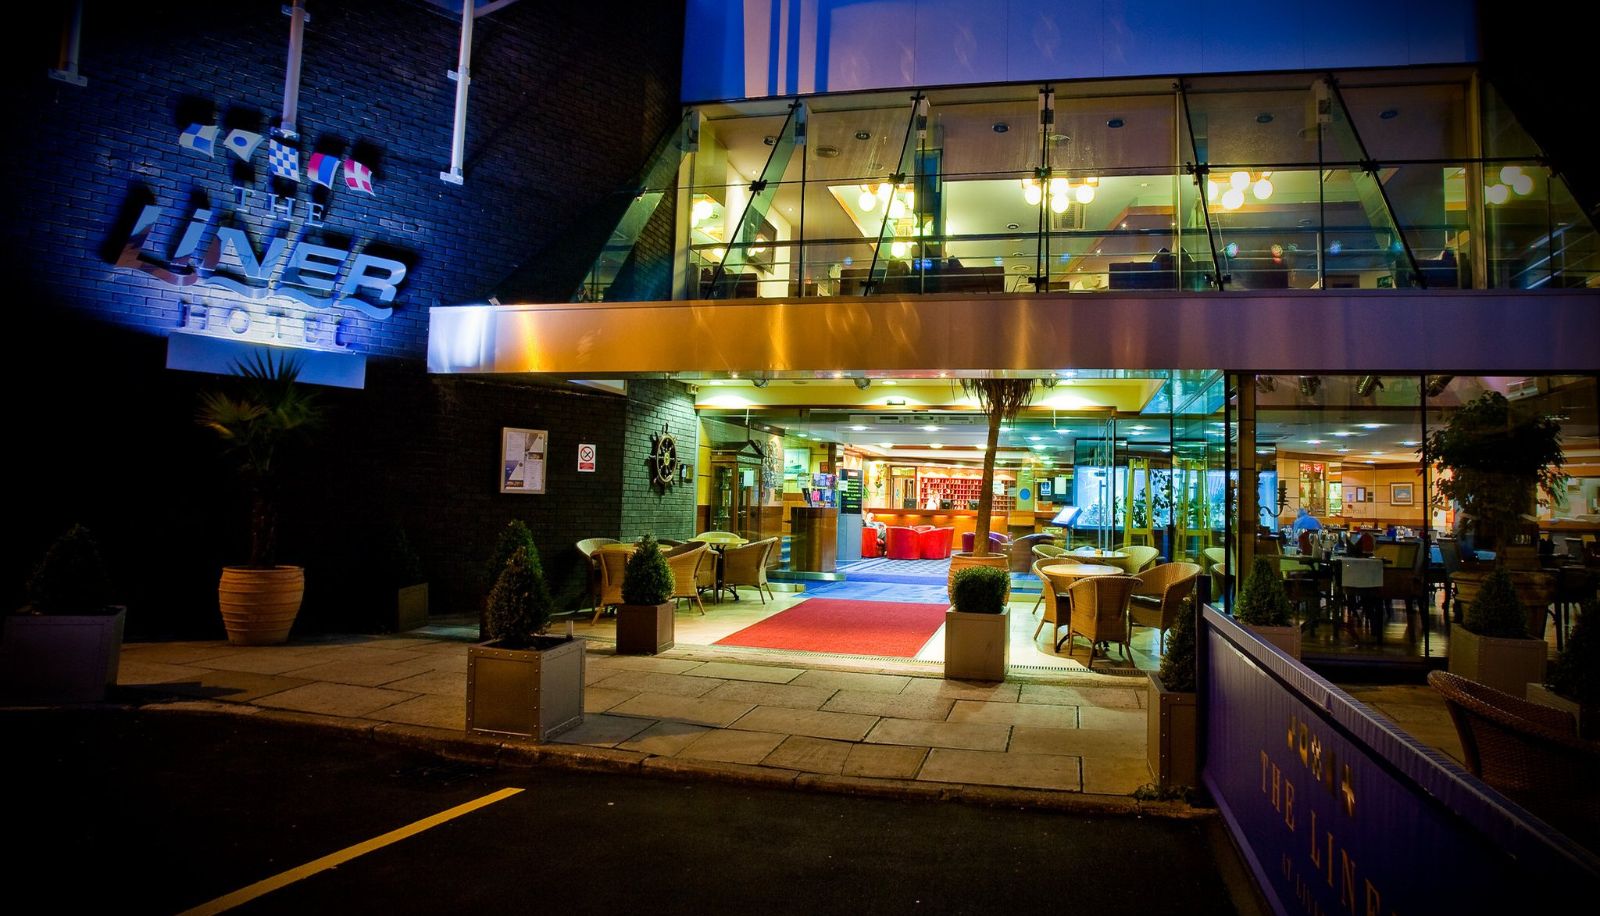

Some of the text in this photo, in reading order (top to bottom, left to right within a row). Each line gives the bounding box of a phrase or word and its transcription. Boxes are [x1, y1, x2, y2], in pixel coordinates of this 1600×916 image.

[230, 185, 326, 228] THE
[182, 303, 348, 348] HOTEL
[1260, 749, 1402, 916] THE LINE
